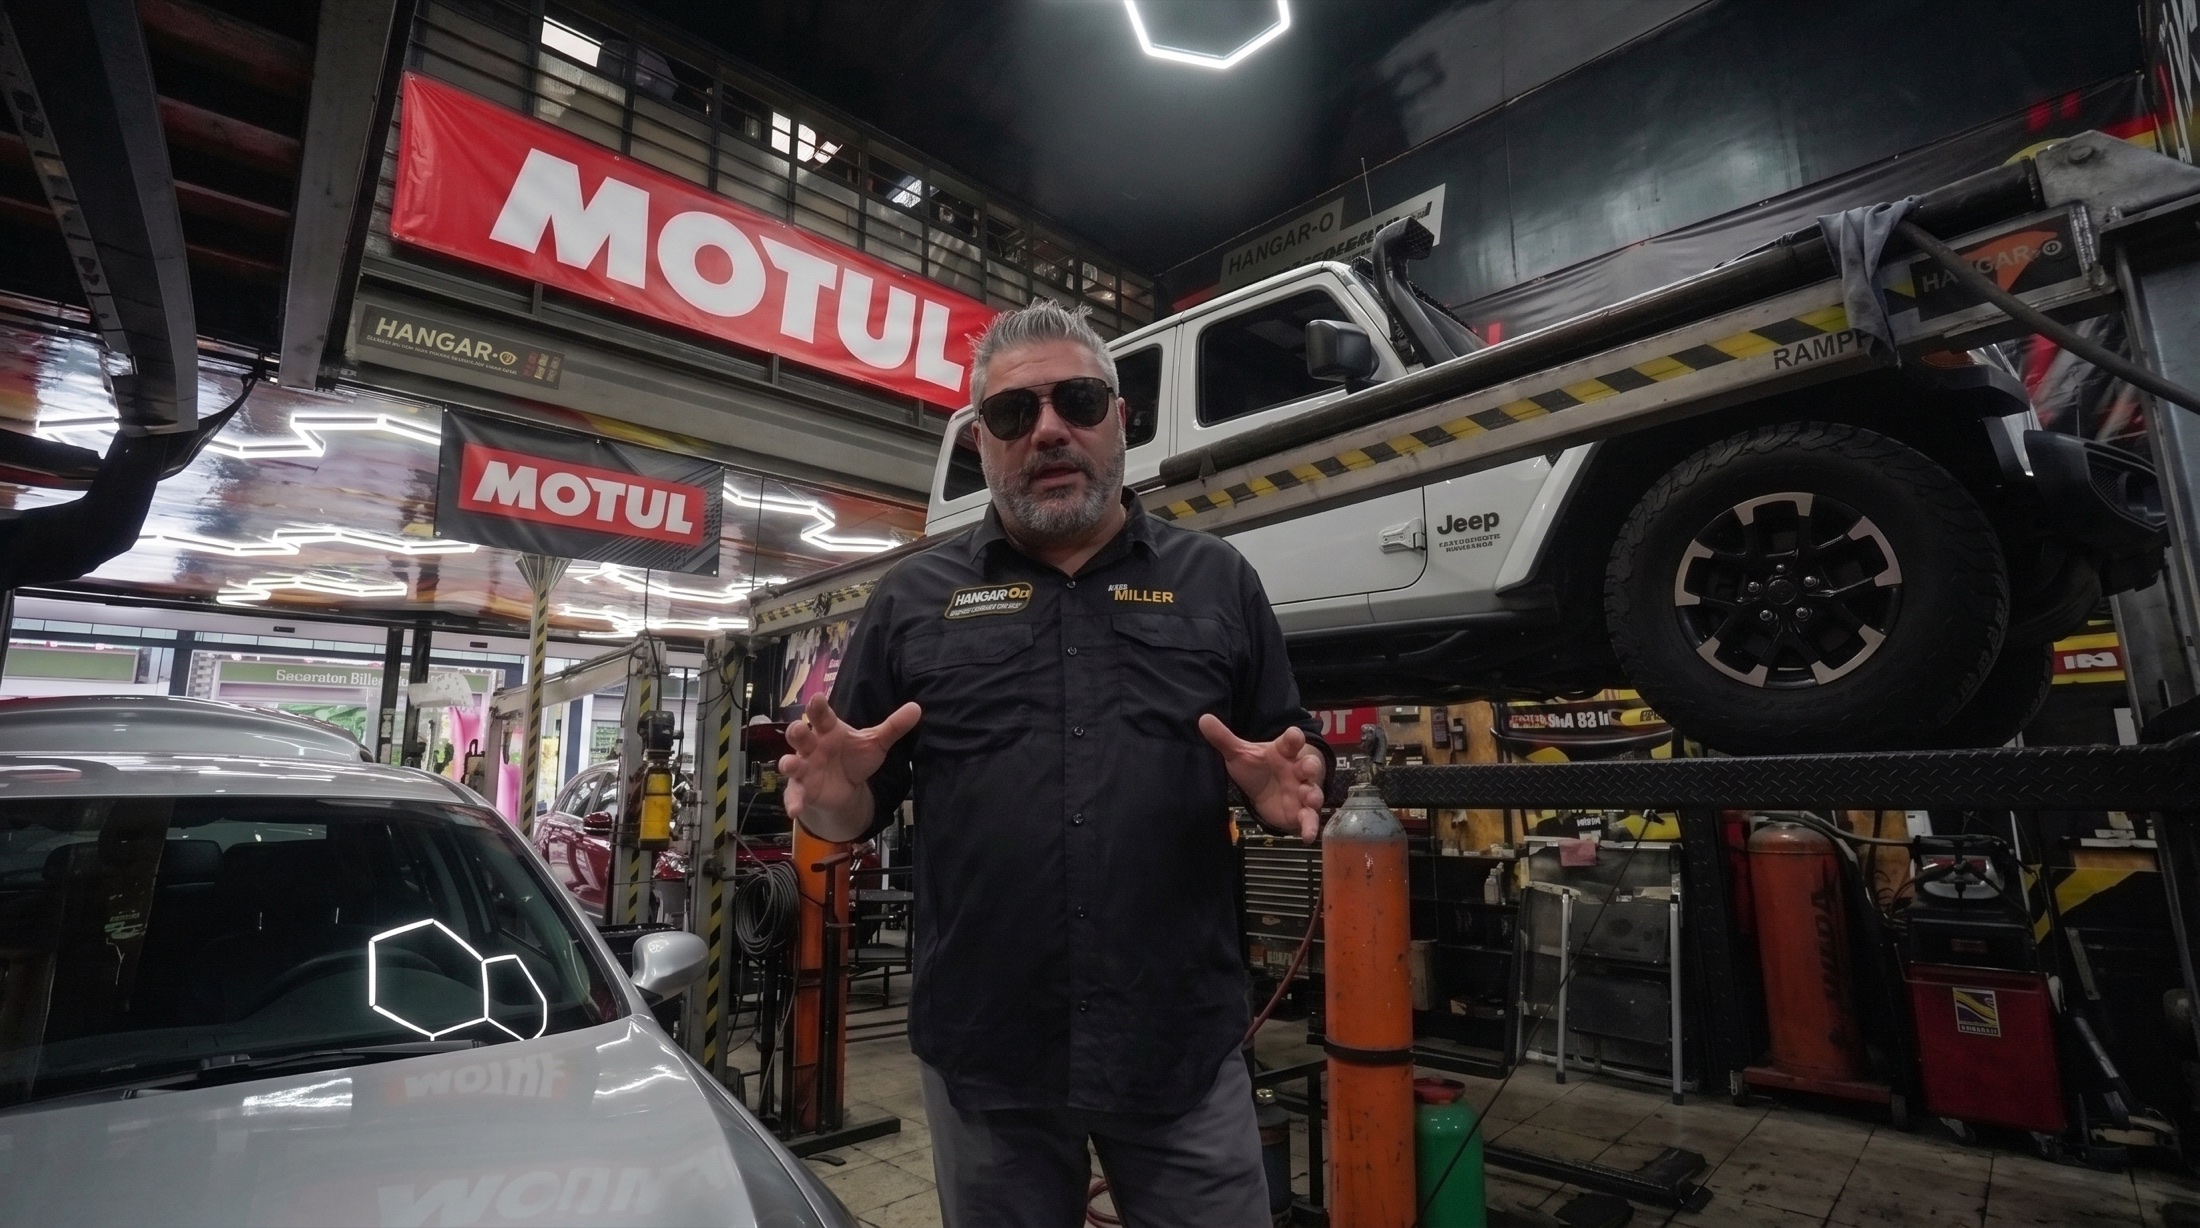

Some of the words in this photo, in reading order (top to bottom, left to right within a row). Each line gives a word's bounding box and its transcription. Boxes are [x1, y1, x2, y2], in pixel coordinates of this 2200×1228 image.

[489, 147, 966, 393] MOTUL
[1228, 211, 1334, 276] HANGAR-O
[472, 460, 693, 535] MOTUL
[1437, 512, 1500, 535] Jeep
[1114, 589, 1174, 604] MILLER
